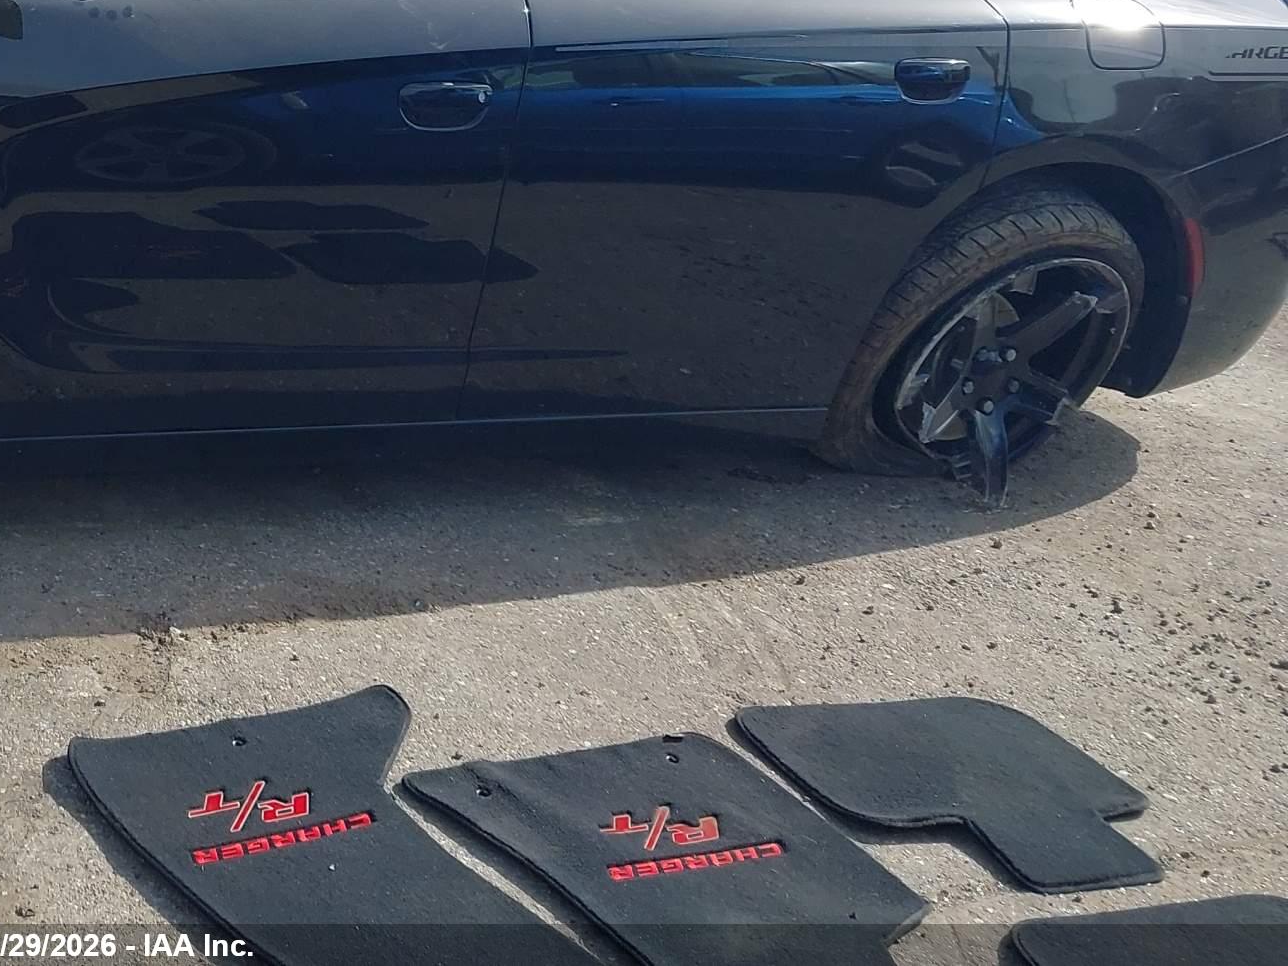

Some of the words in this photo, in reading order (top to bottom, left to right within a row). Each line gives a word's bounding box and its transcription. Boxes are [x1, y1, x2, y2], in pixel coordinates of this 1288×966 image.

[188, 780, 310, 832] R/T
[599, 805, 719, 850] R/T
[193, 812, 372, 865] CHARGER
[607, 842, 783, 882] CHARGER
